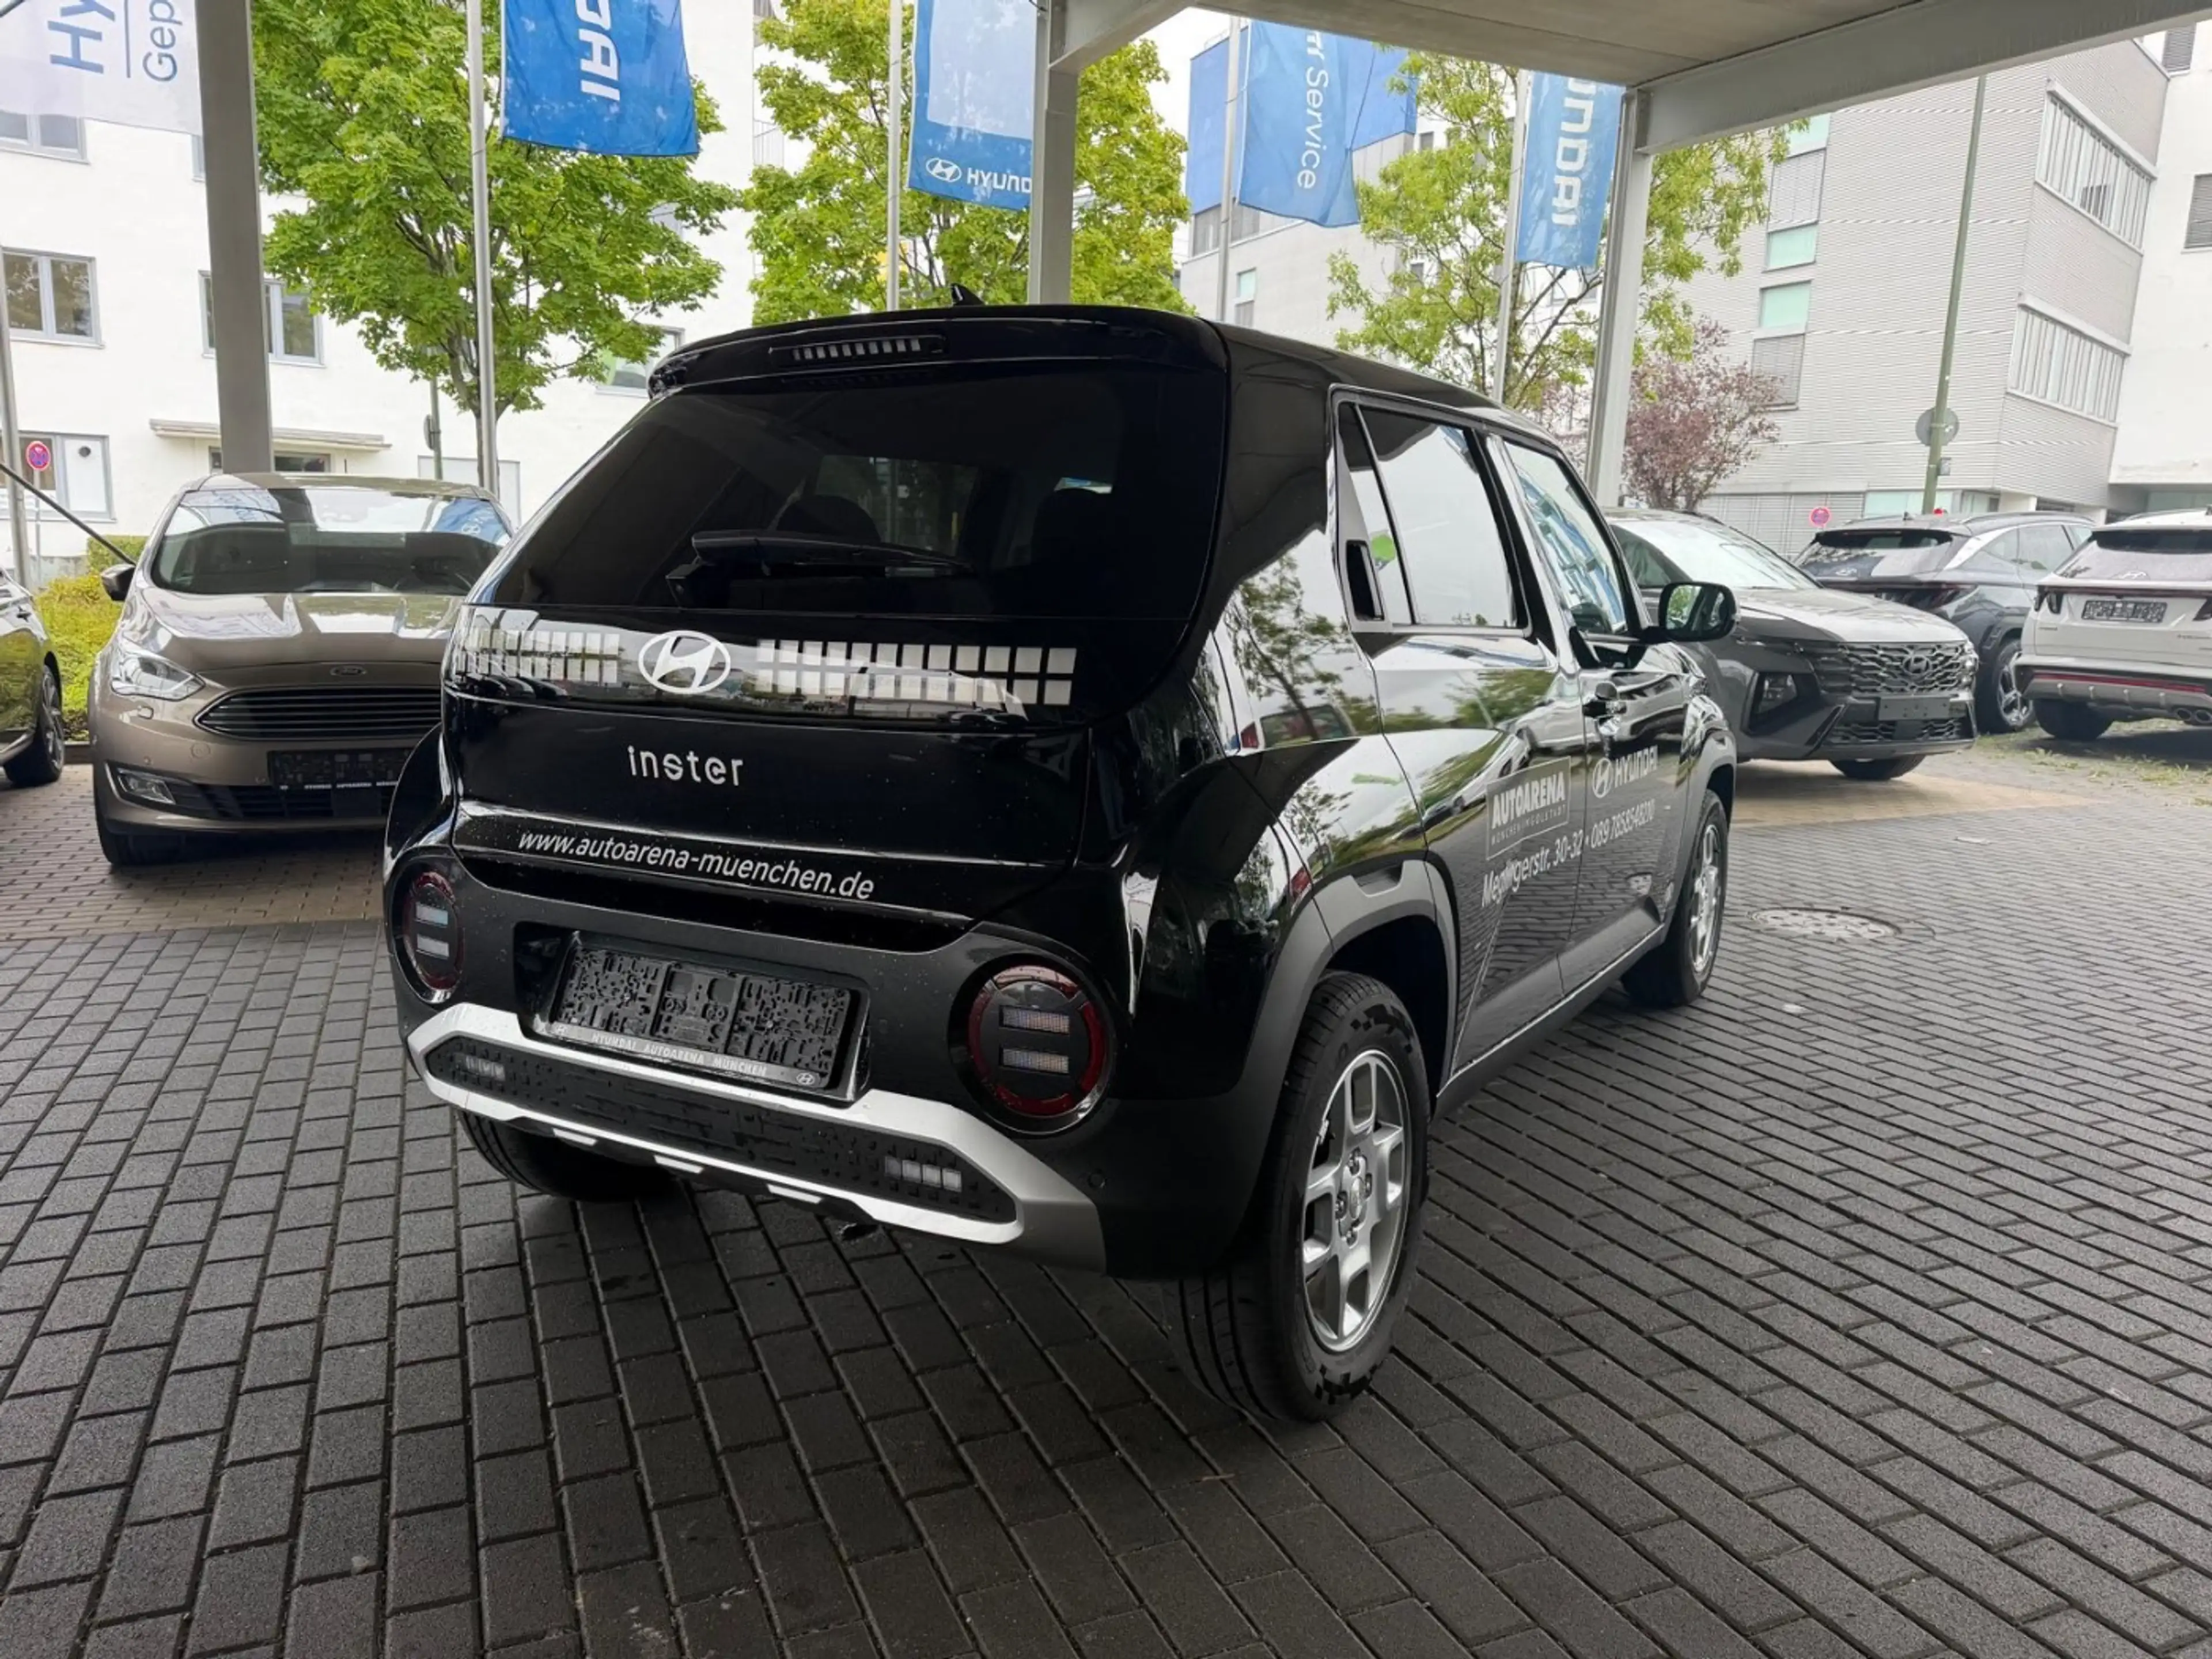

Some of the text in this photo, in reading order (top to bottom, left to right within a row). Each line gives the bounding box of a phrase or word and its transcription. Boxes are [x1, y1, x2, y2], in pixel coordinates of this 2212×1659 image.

[142, 0, 183, 82] Gep
[1297, 66, 1329, 189] Service
[967, 167, 1032, 194] HYUND
[627, 745, 744, 786] inster
[1615, 744, 1658, 788] HYUNDAI
[1491, 772, 1566, 830] AUTOARENA
[518, 832, 874, 900] www.autoarena-muenchen.de
[644, 1044, 704, 1065] AUTOARENA
